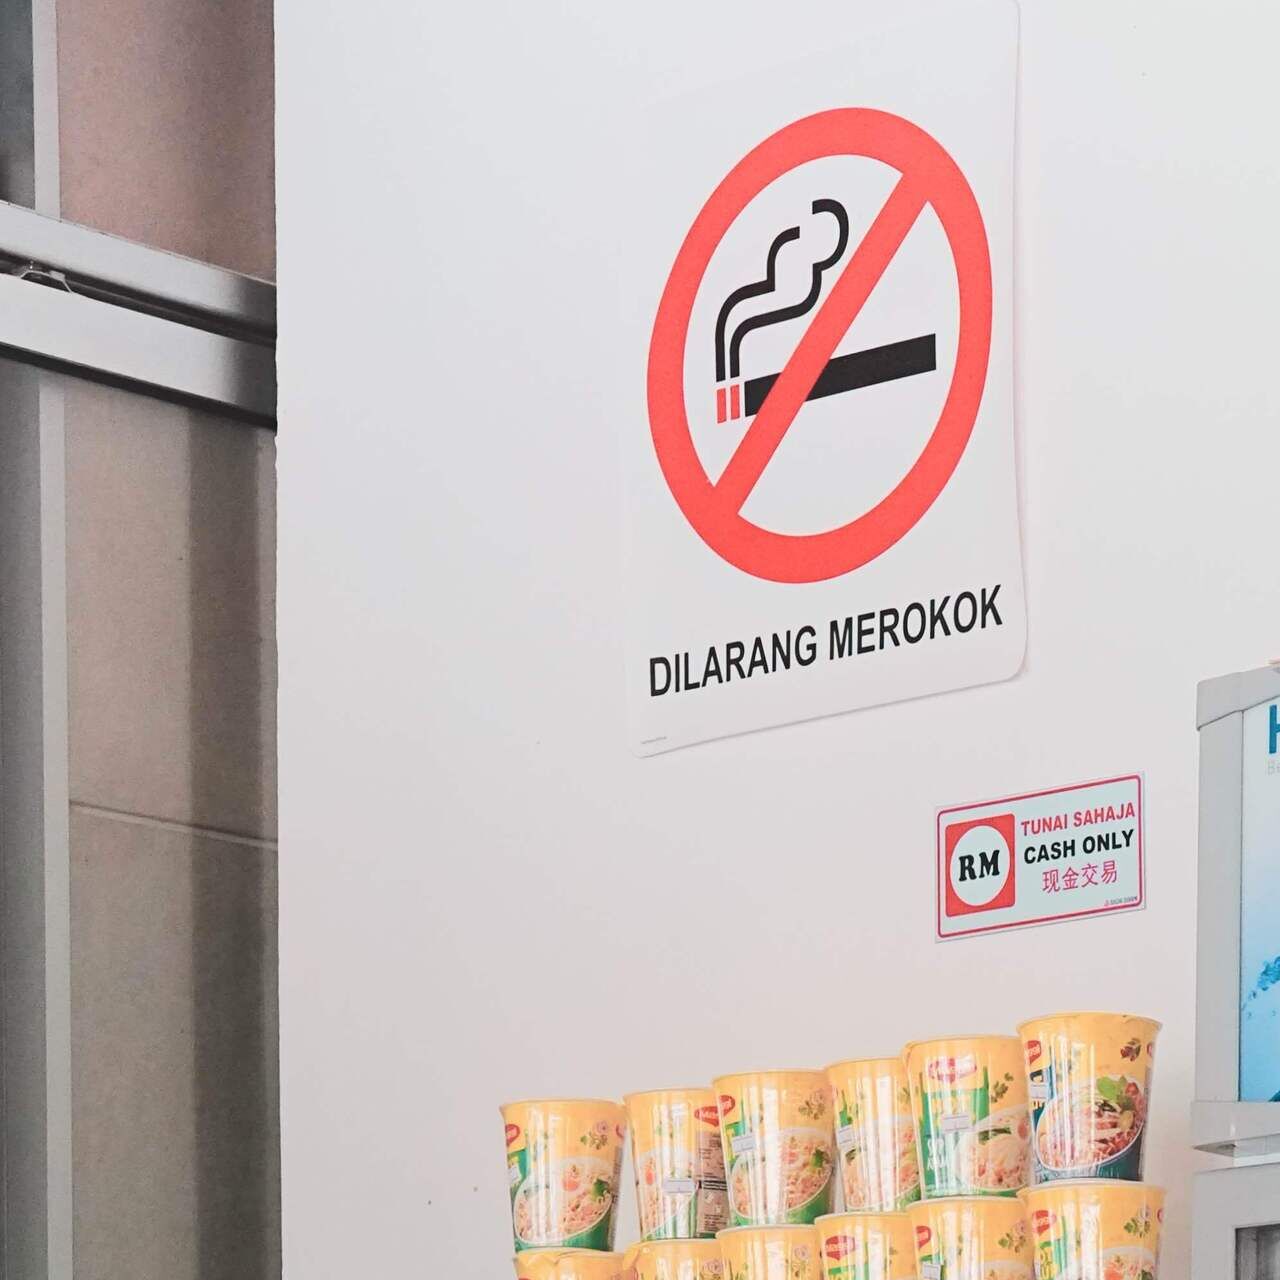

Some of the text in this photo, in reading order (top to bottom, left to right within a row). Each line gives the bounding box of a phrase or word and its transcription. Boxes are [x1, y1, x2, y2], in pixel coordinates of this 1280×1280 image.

[649, 584, 1003, 697] DILARANG MEROKOK
[1021, 802, 1136, 836] TUNAI SAHAJA
[1024, 828, 1134, 864] CASH ONLY
[958, 849, 1000, 882] RM
[1042, 860, 1117, 893] 现金交易
